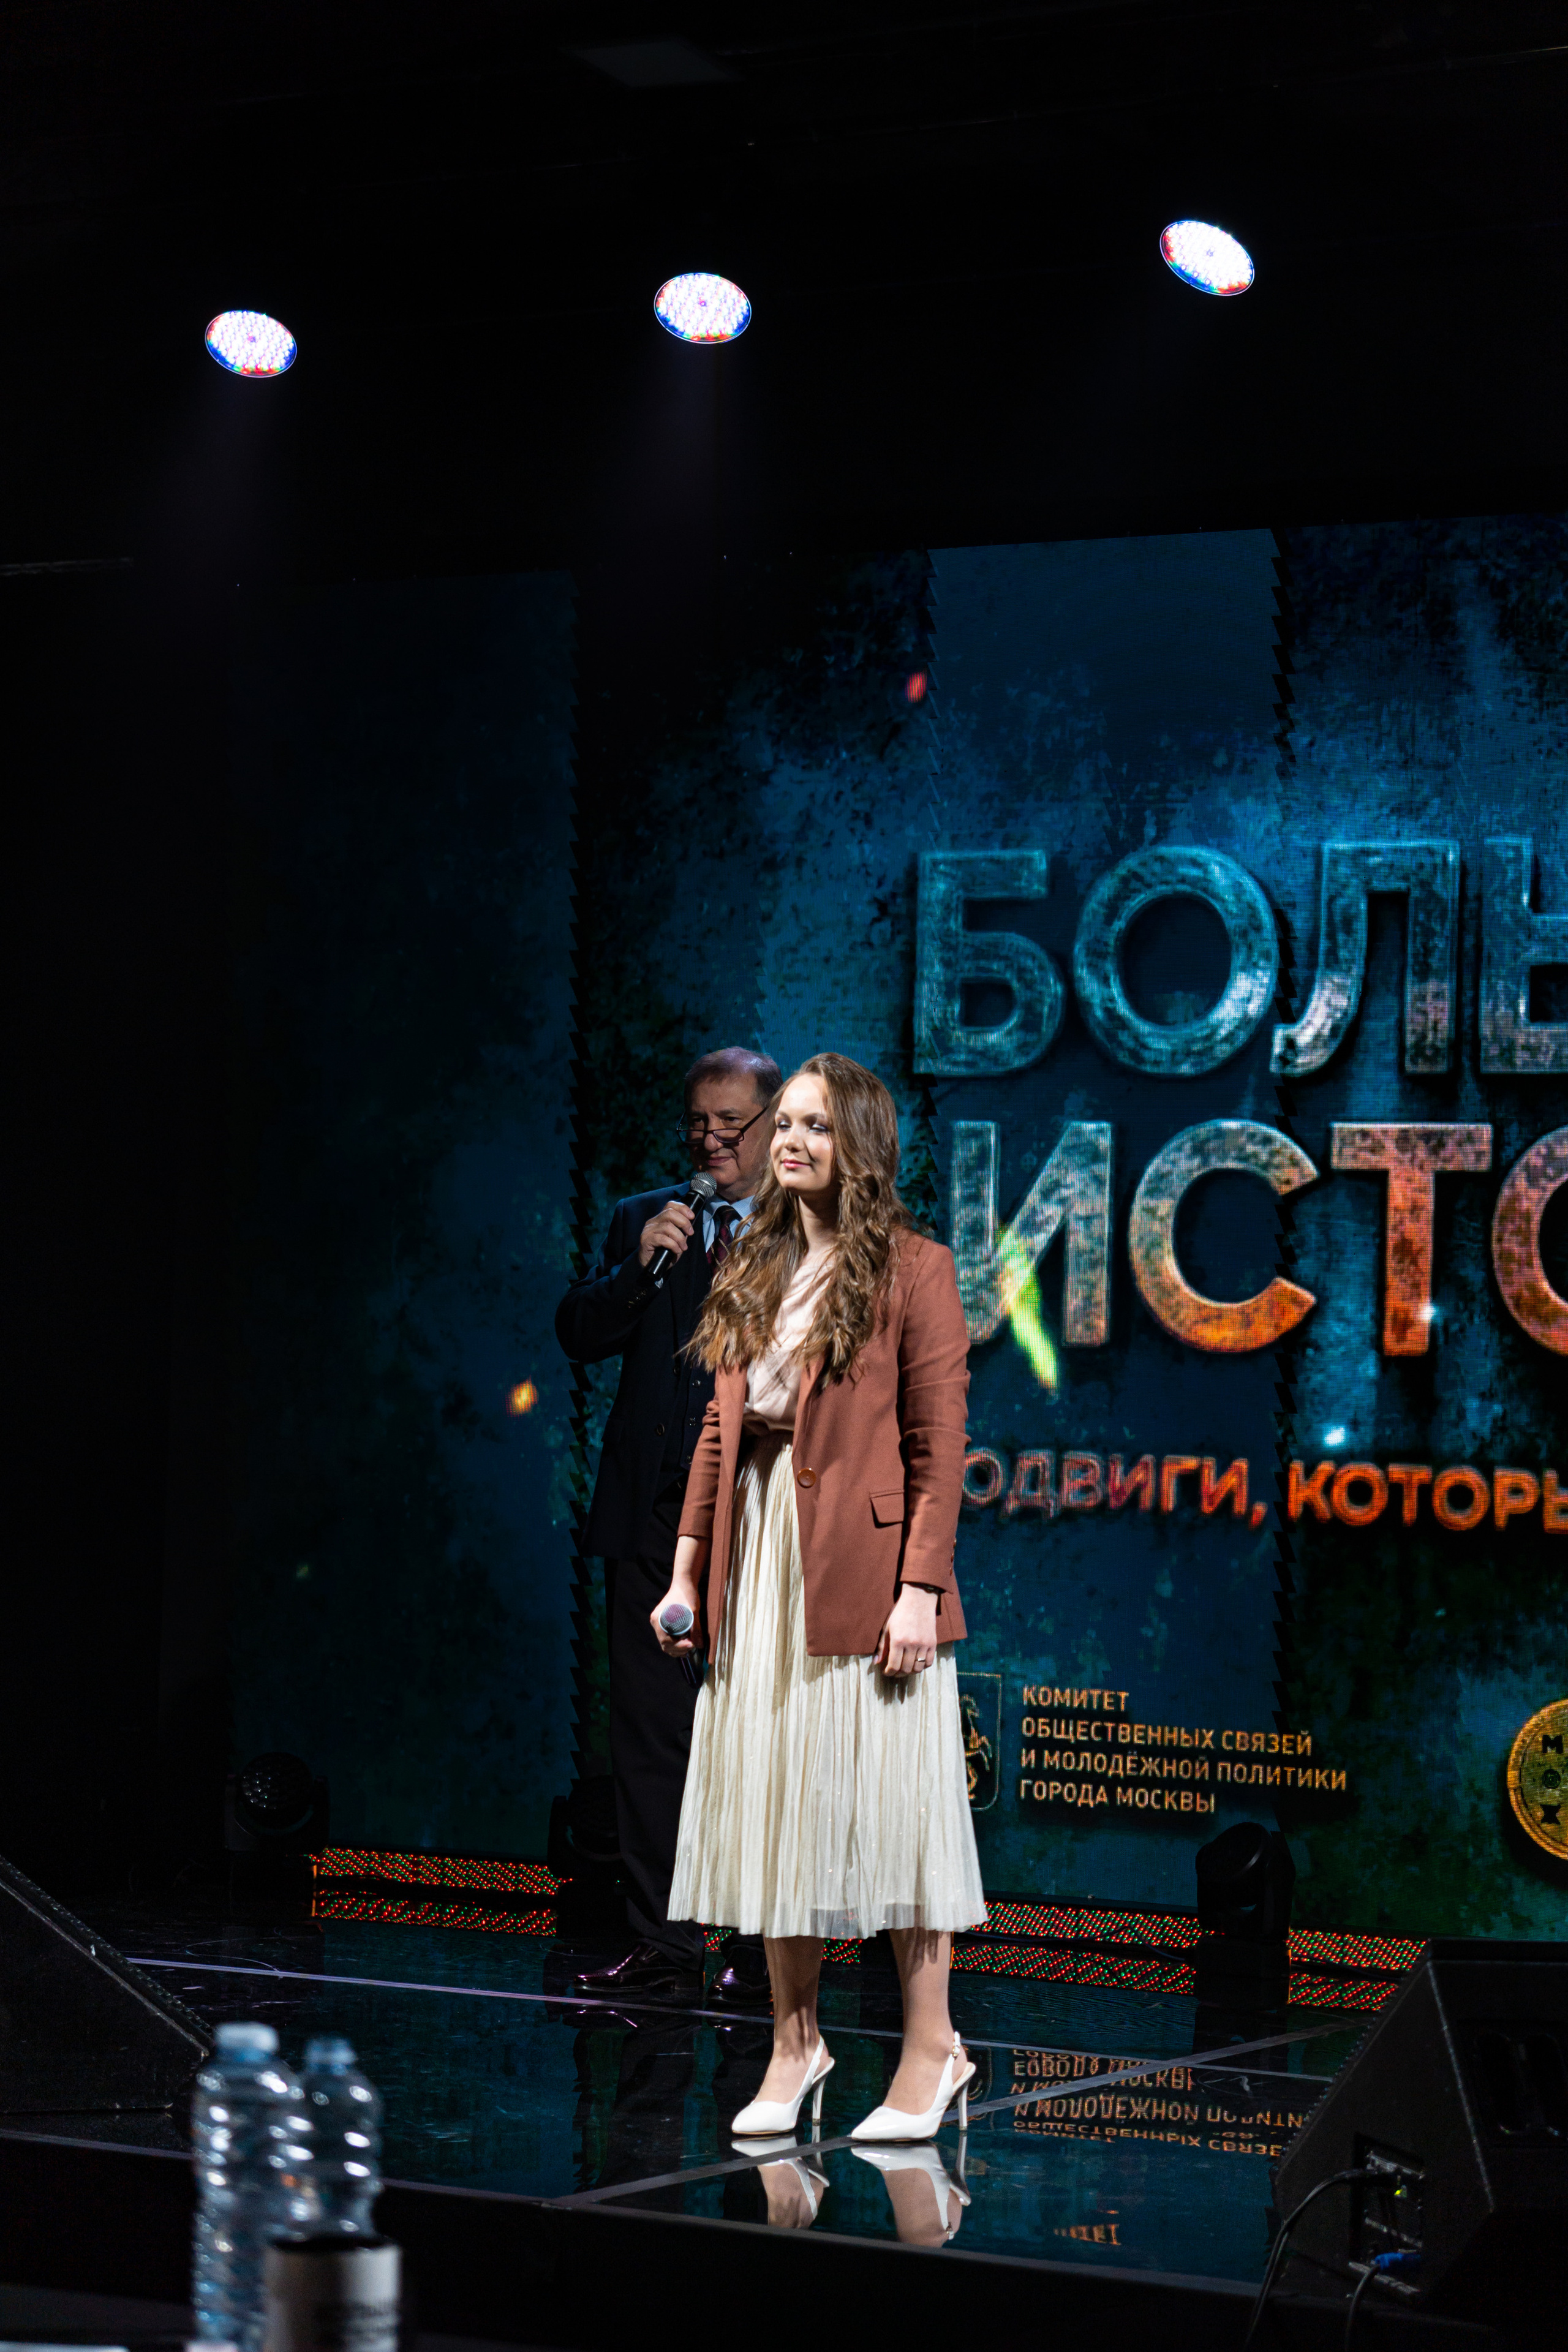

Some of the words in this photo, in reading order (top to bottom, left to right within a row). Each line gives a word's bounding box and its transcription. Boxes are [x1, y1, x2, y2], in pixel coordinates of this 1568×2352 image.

[1022, 1684, 1129, 1711] КОМИТЕТ
[1022, 1717, 1215, 1749] ОБЩЕСТВЕННЫХ
[1221, 1729, 1313, 1757] СВЯЗЕЙ
[1021, 1748, 1036, 1769] И
[1043, 1750, 1210, 1780] МОЛОДЁЖНОЙ
[1217, 1762, 1347, 1792] ПОЛИТИКИ
[1020, 1779, 1108, 1807] ГОРОДА
[1115, 1787, 1216, 1813] МОСКВЫ
